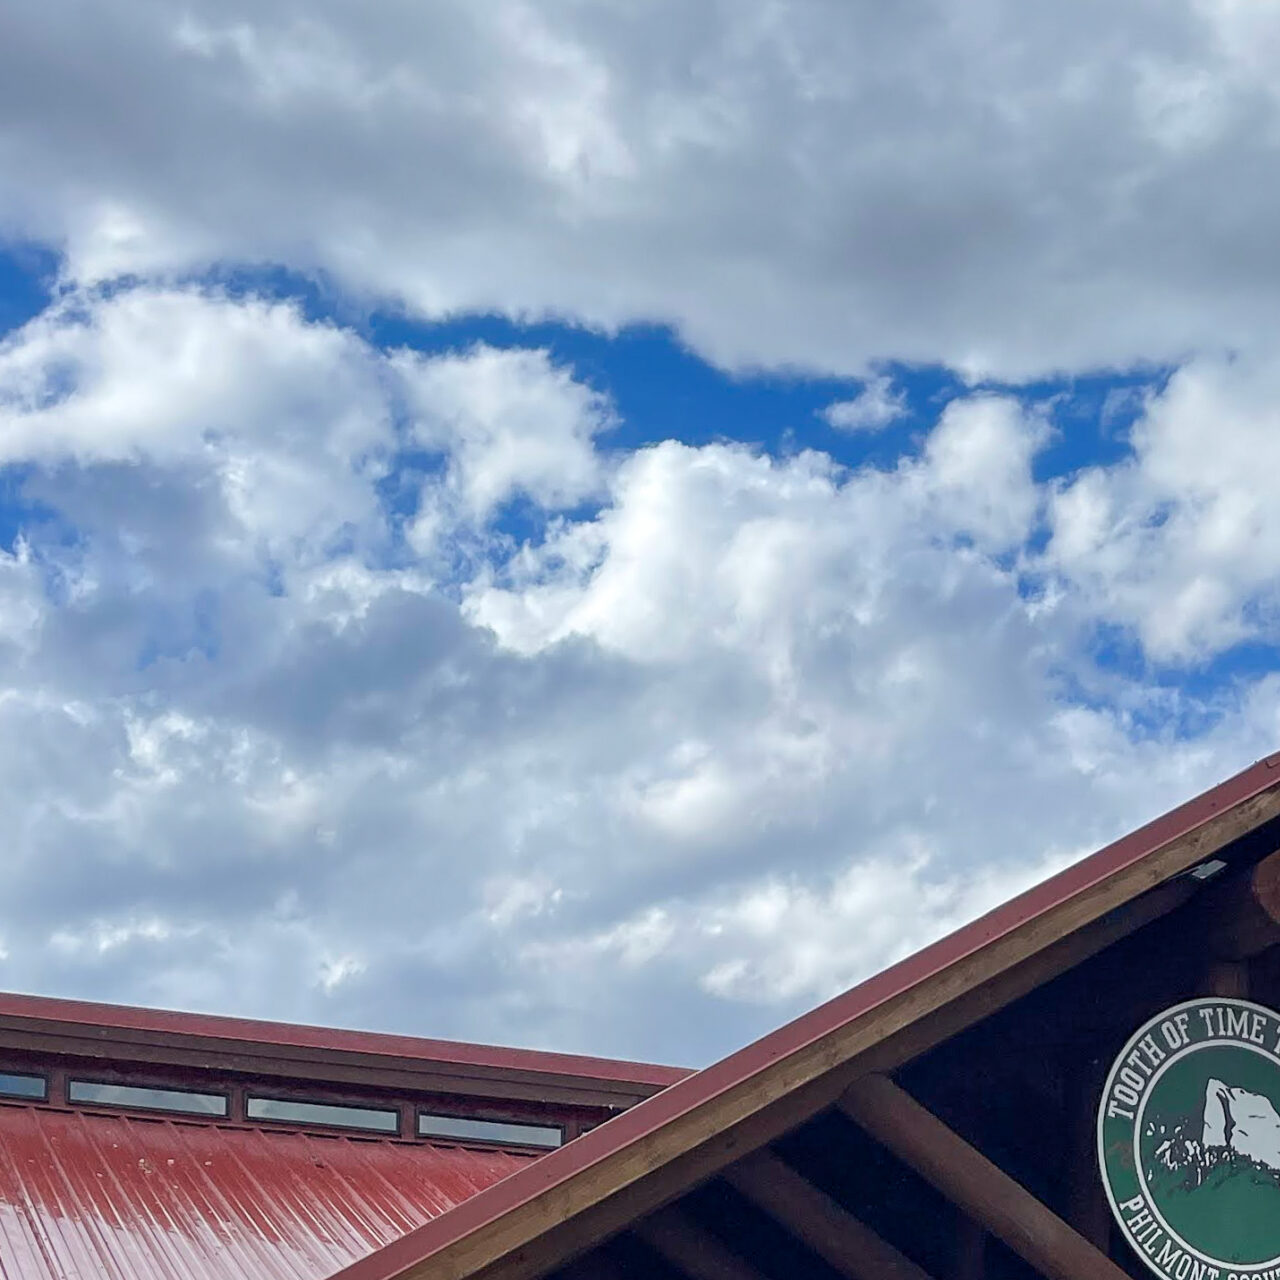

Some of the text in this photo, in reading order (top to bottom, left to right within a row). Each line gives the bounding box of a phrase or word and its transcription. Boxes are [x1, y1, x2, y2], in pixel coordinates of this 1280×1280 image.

[1108, 1036, 1166, 1120] TOOTH
[1161, 1012, 1190, 1050] OF
[1200, 1008, 1267, 1043] TIME
